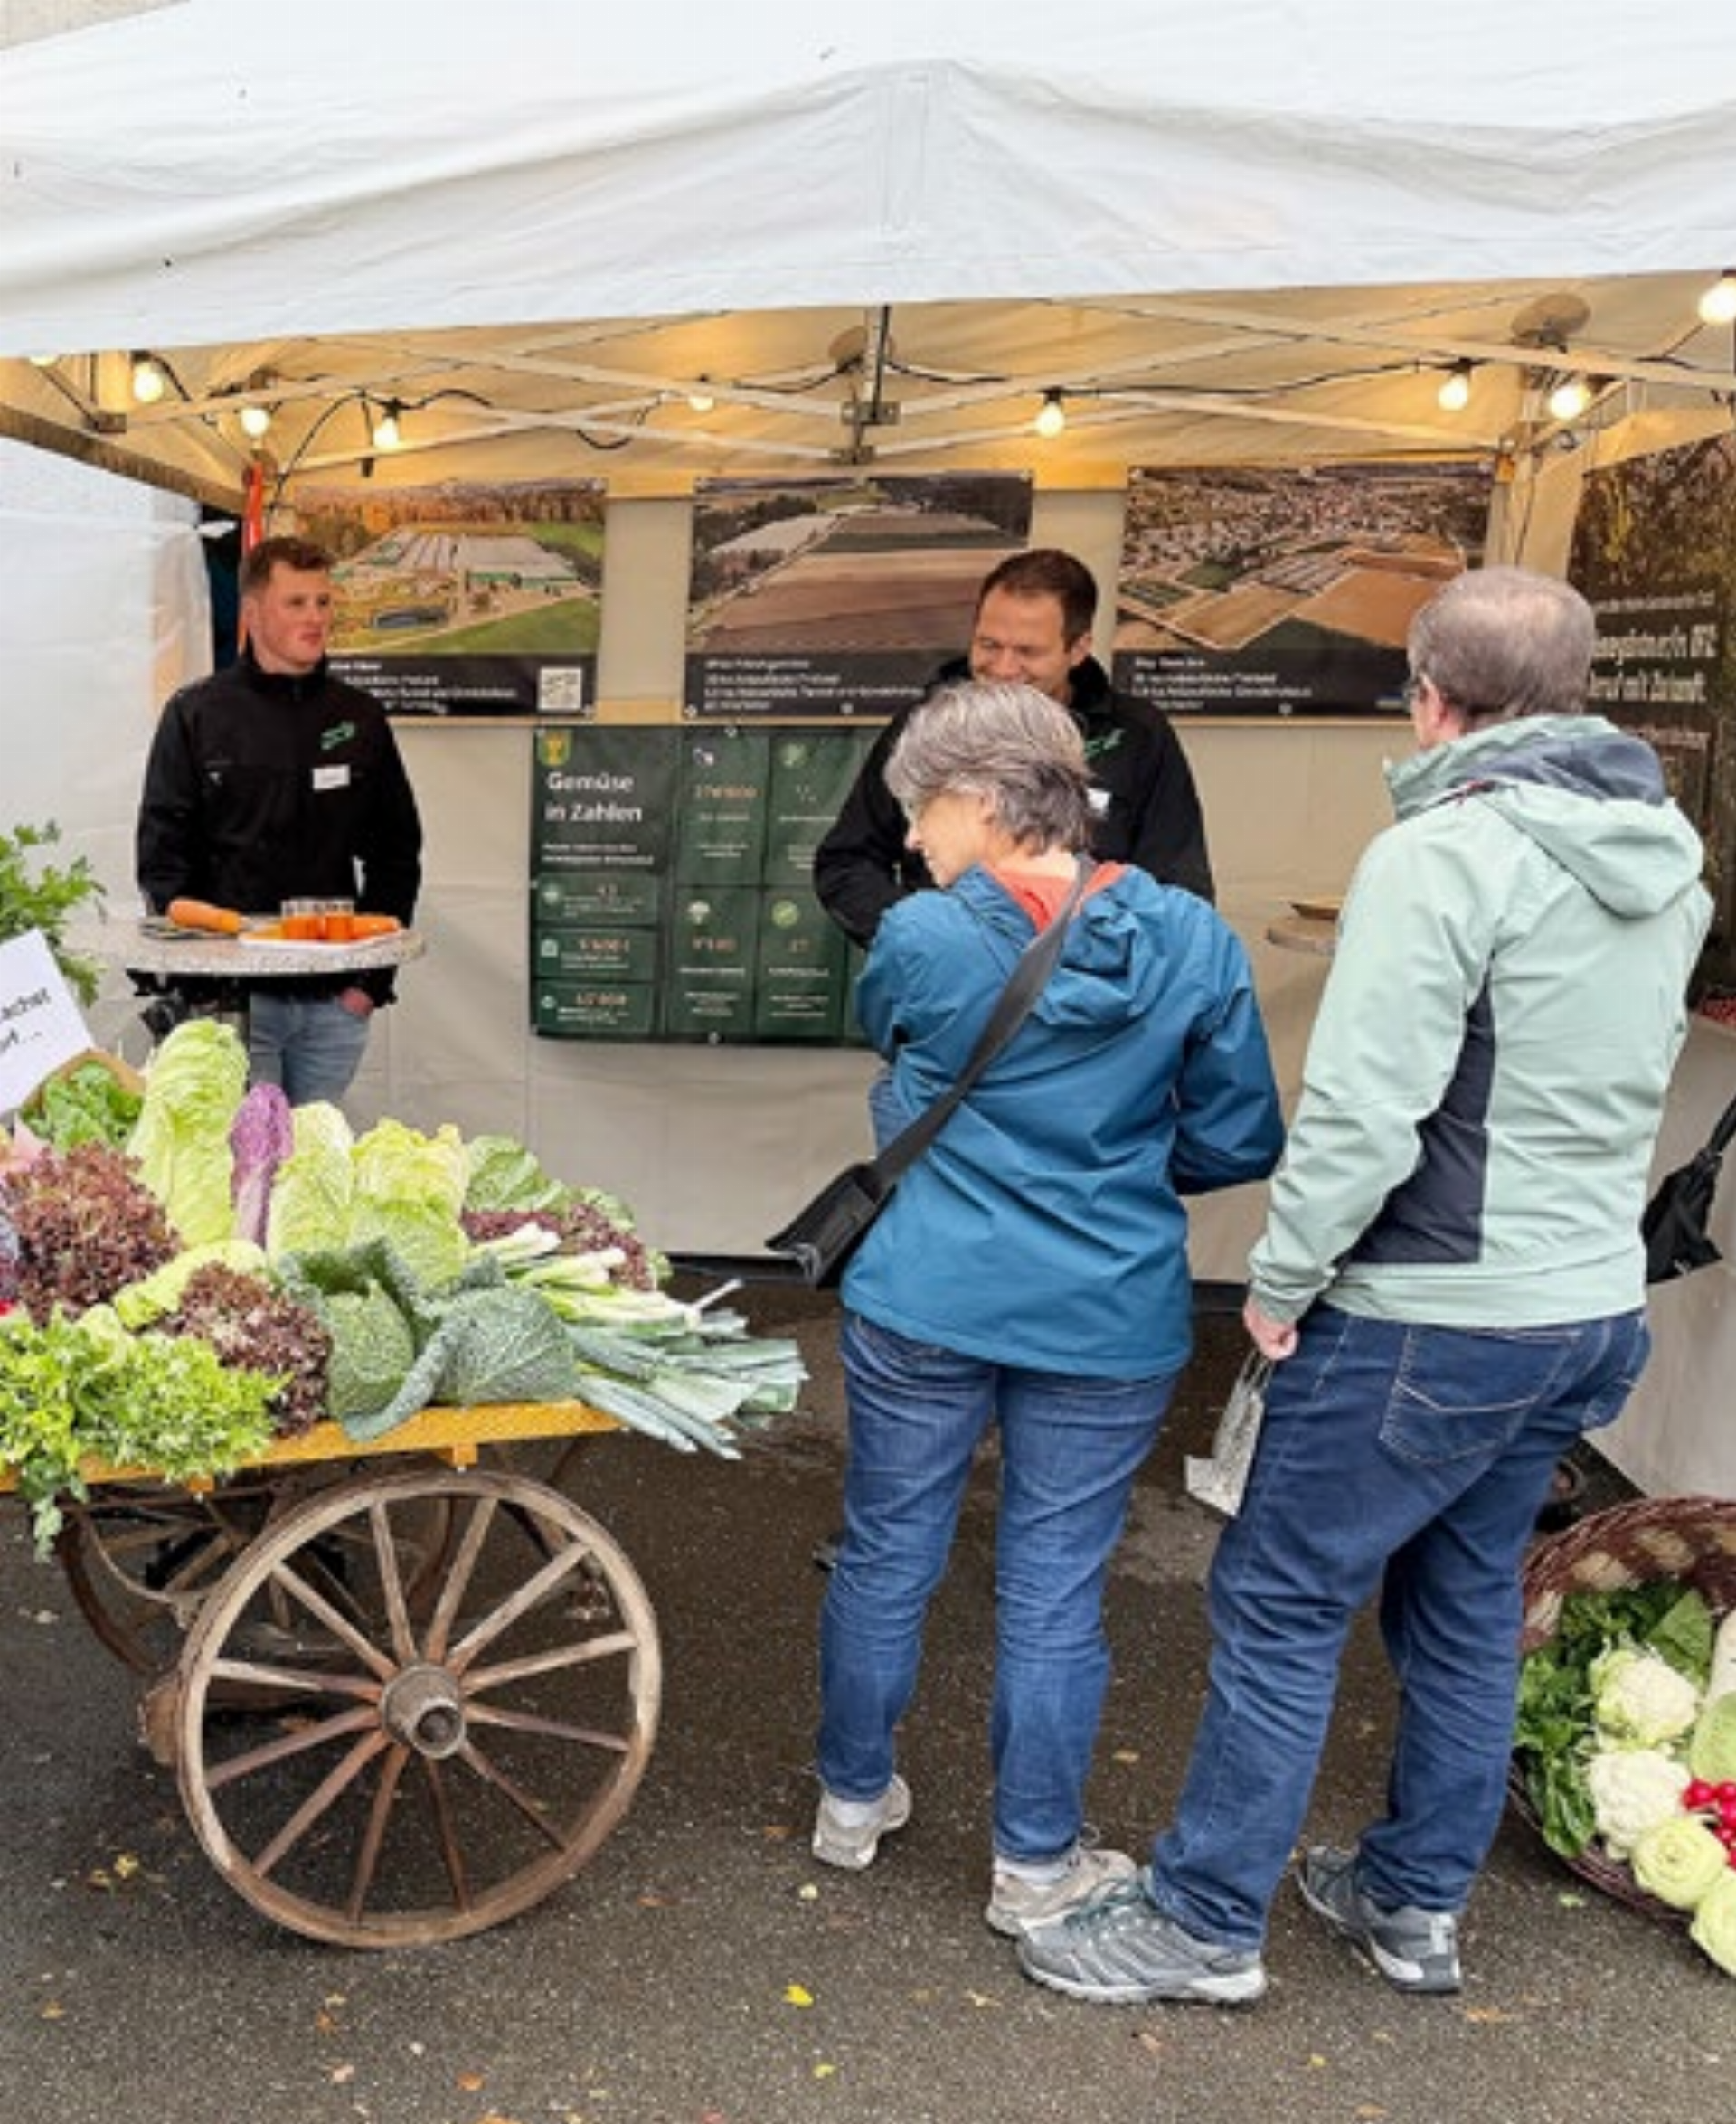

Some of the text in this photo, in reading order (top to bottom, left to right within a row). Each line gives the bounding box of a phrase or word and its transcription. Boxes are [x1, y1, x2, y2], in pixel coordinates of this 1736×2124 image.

[547, 771, 635, 793] Gemüse
[545, 801, 644, 824] in Zahlen
